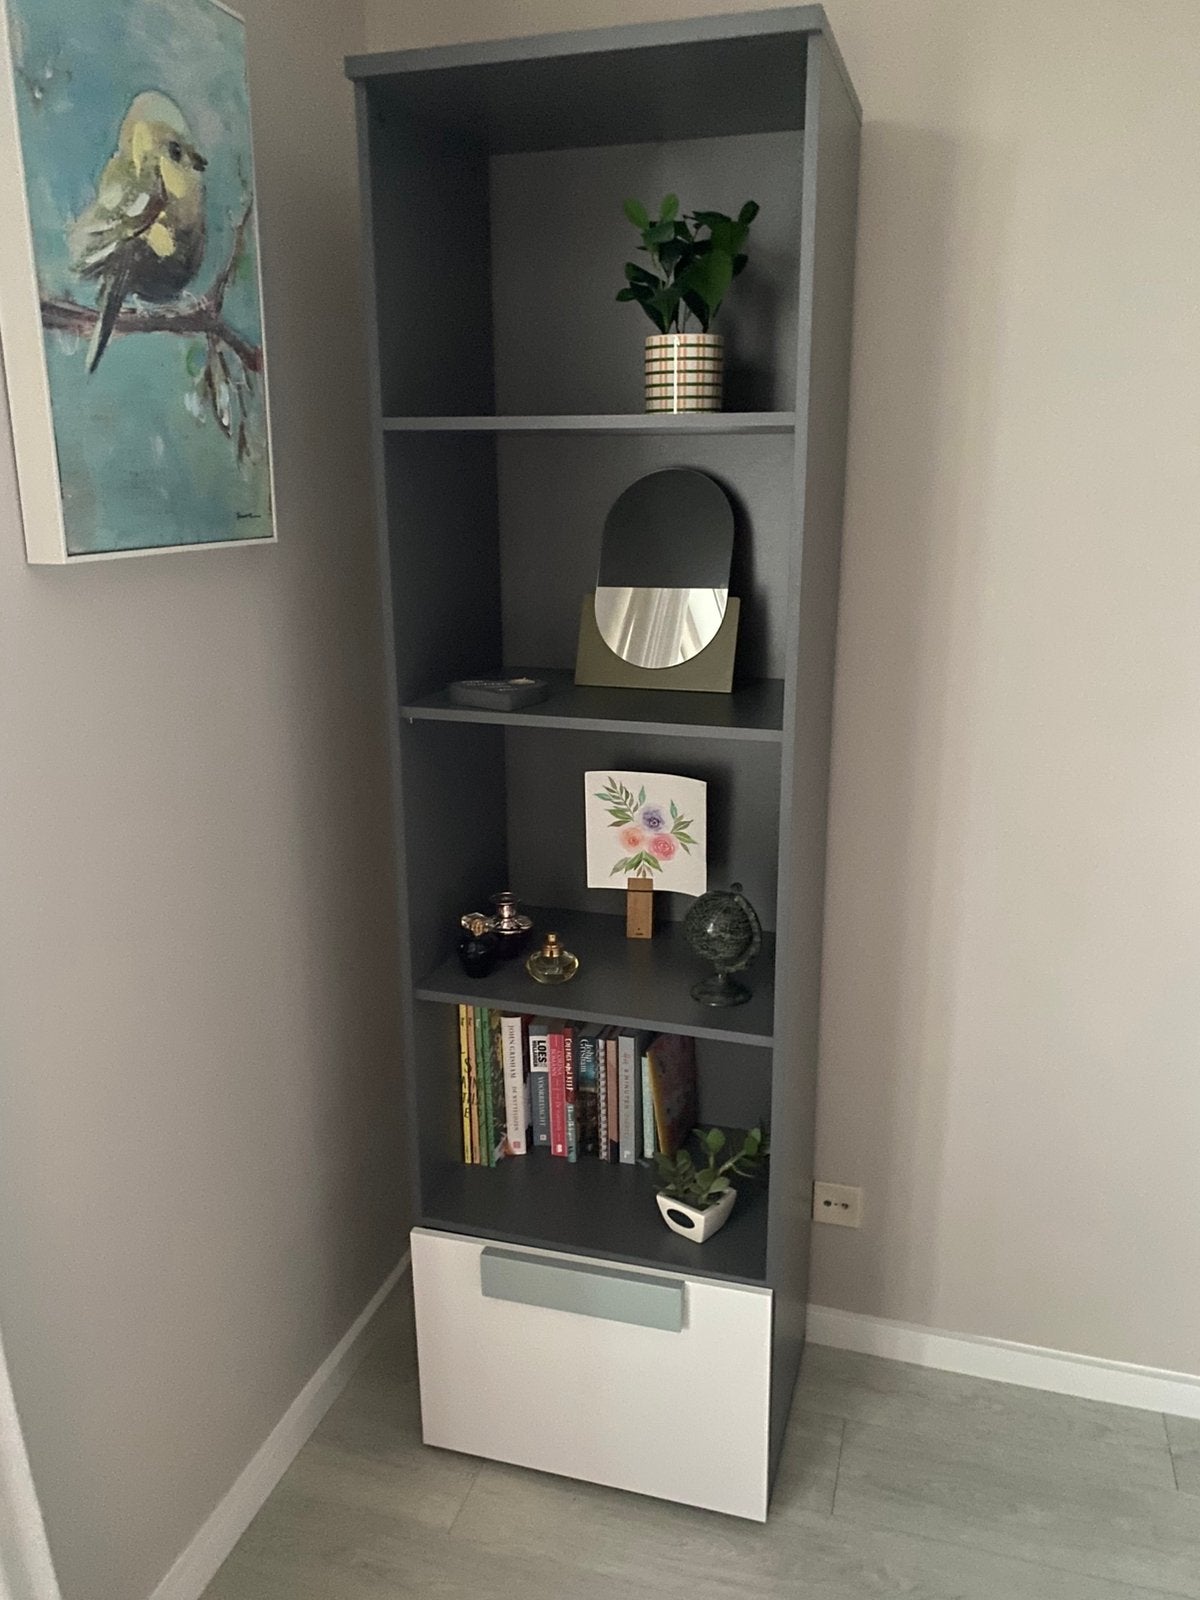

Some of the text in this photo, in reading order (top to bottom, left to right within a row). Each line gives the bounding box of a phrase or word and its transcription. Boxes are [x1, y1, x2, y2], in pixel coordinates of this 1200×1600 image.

[508, 1024, 518, 1079] JOHN GRISHAM
[537, 1040, 548, 1064] LOES
[579, 1038, 588, 1073] Grisham
[584, 1042, 595, 1063] John
